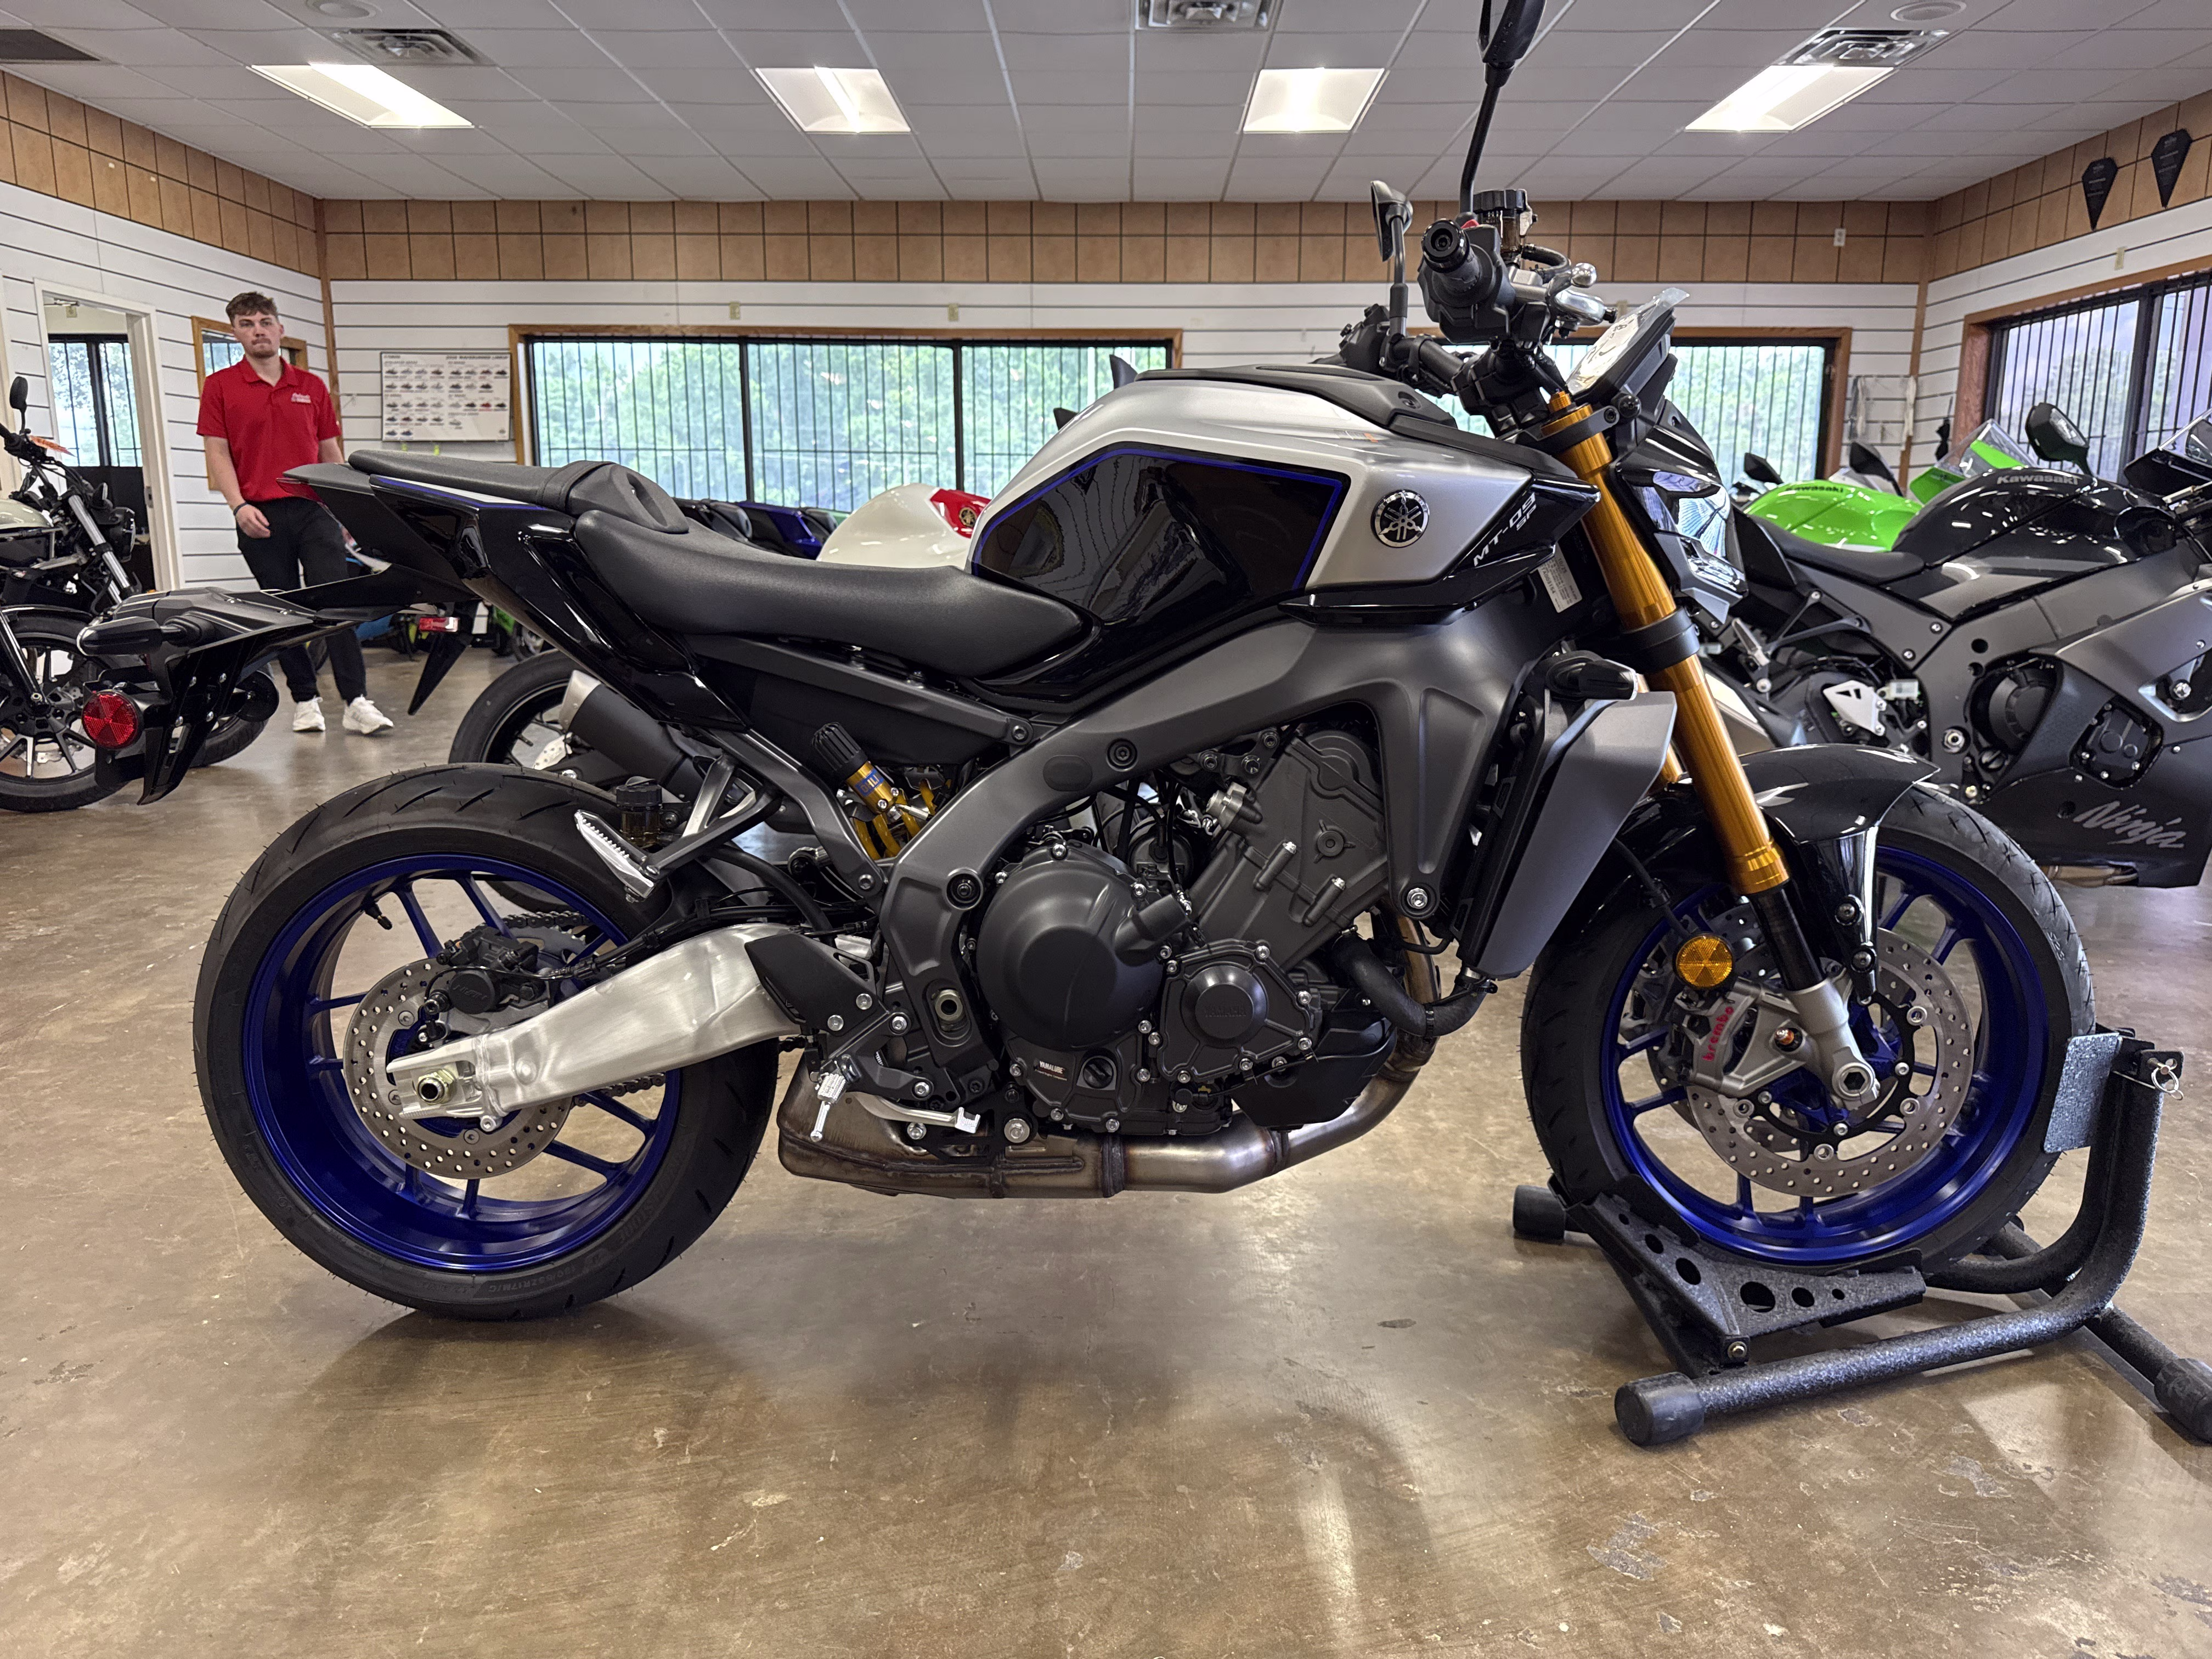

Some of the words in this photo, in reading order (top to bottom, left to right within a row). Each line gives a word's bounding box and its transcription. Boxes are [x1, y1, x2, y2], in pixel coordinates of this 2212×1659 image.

[1997, 473, 2079, 486] Kawasaki
[1473, 492, 1536, 567] MT-09
[1516, 504, 1537, 531] SP
[2073, 800, 2187, 848] Ninja
[1702, 1006, 1735, 1062] brembo
[1039, 1060, 1065, 1074] YAMALUBE
